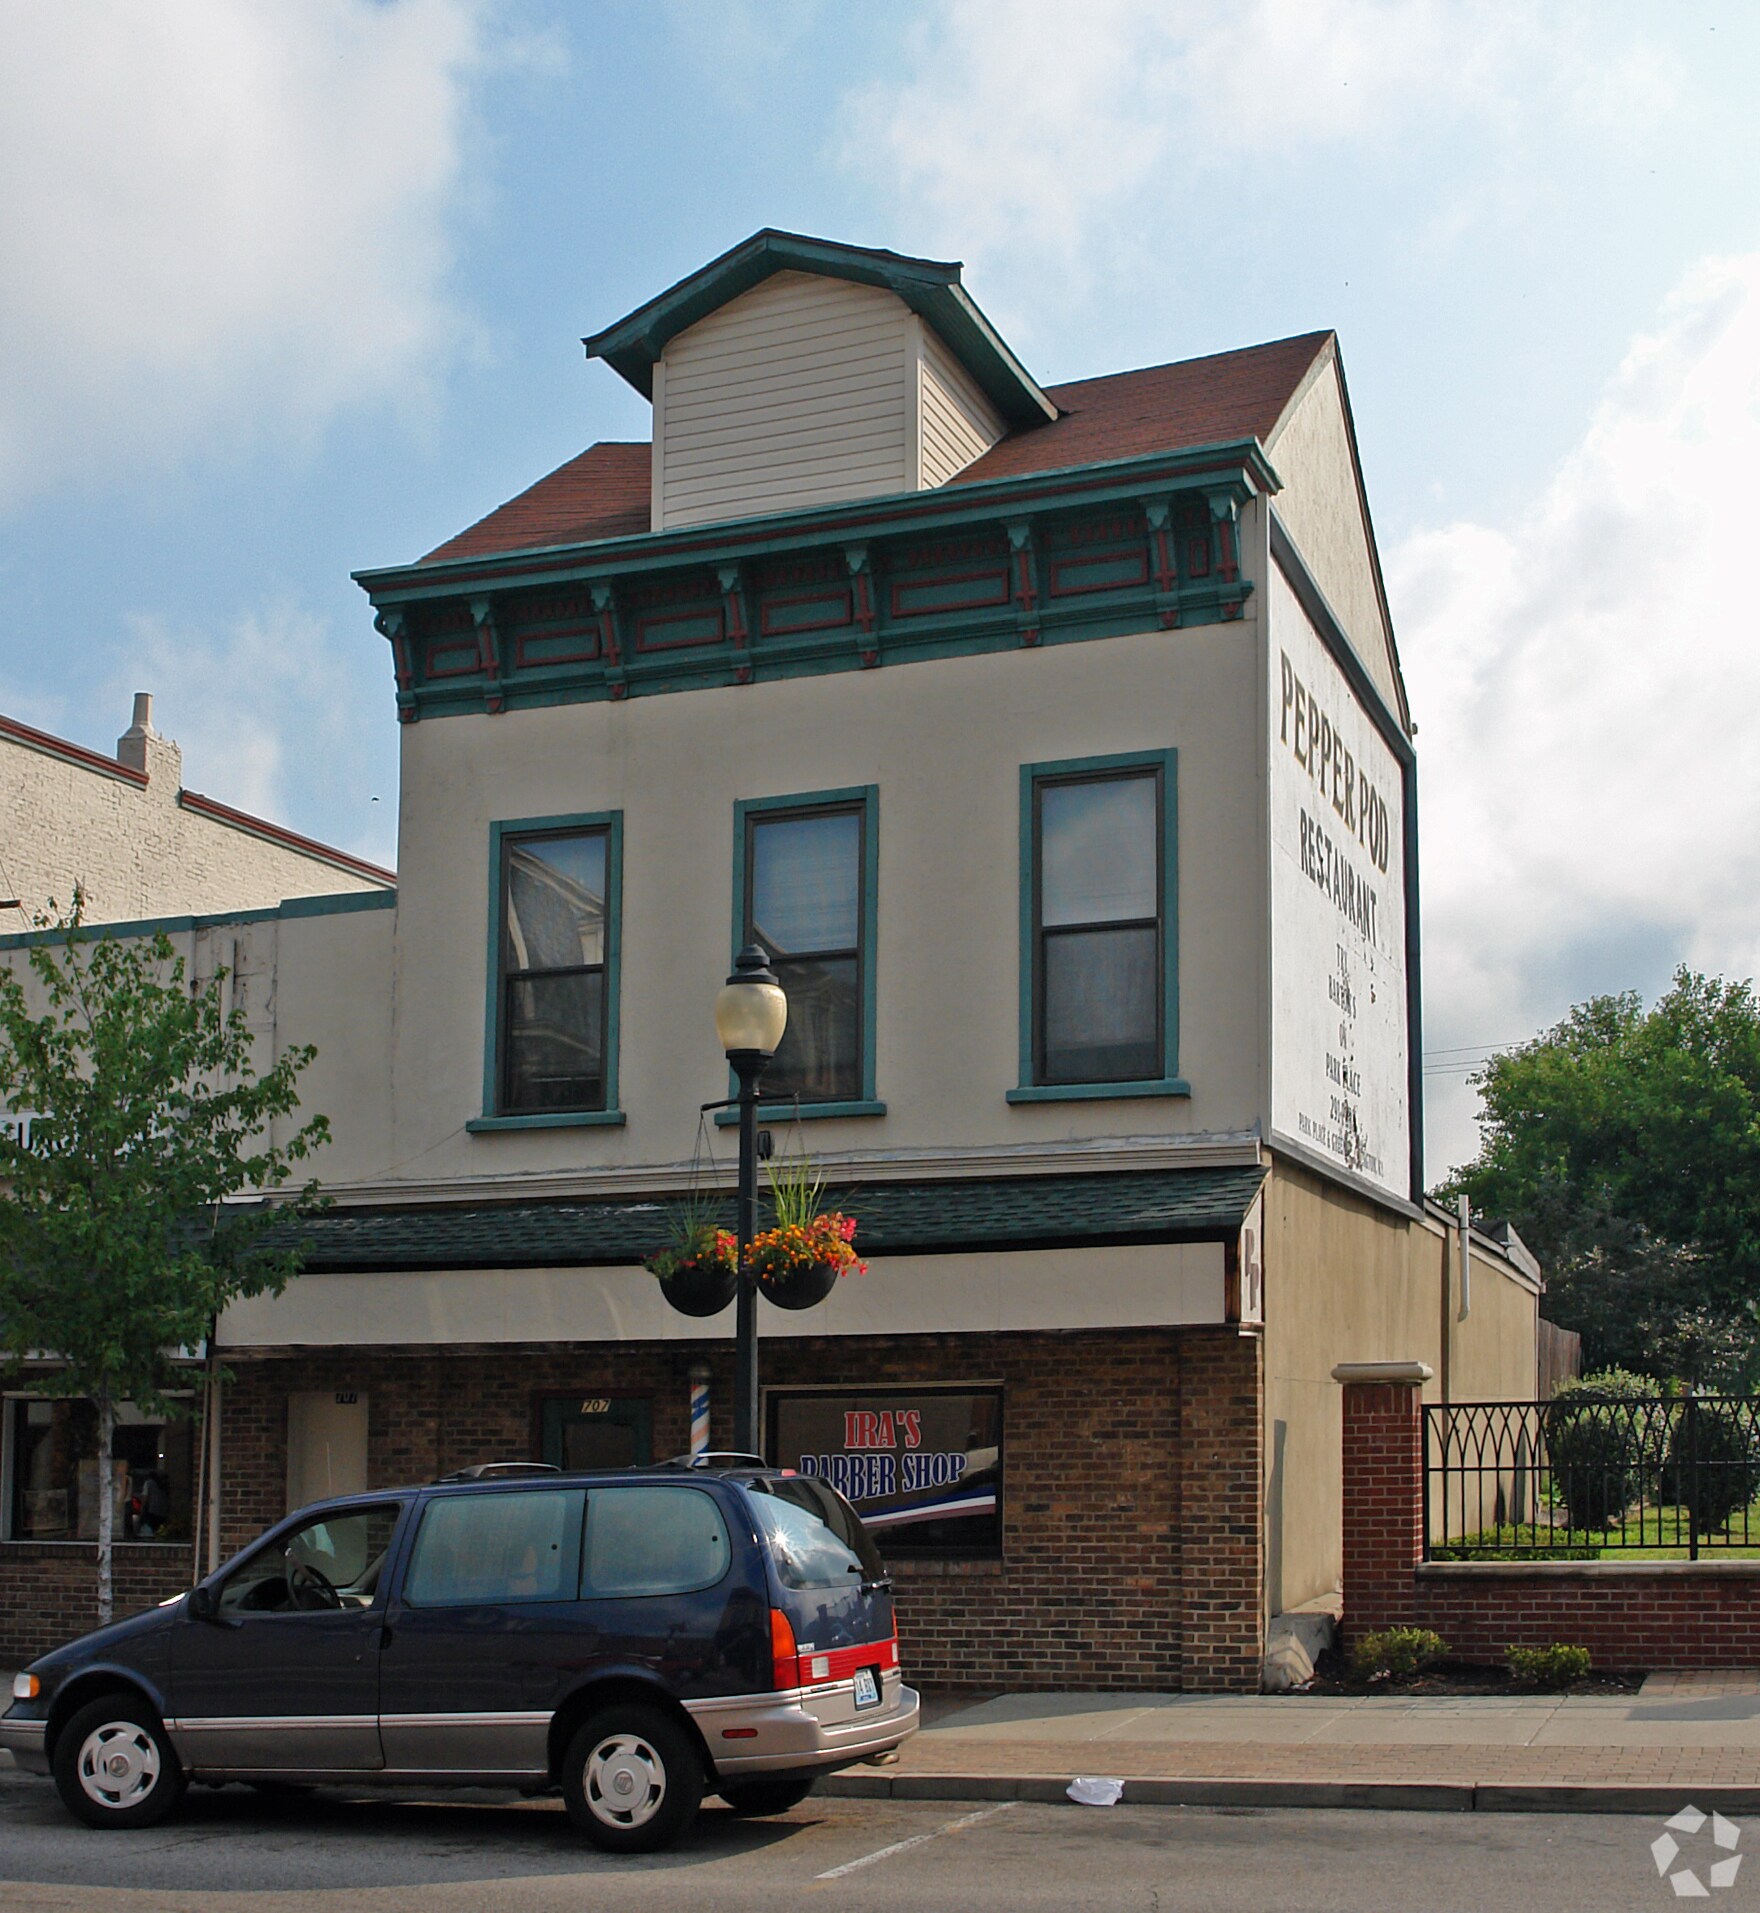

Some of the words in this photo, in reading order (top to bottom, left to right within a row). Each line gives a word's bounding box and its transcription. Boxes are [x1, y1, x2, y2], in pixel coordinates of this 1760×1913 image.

[1280, 646, 1356, 835] PEPPER
[1359, 767, 1389, 875] POD
[1300, 806, 1376, 948] RESTAURANT
[1326, 1052, 1341, 1086] PARK
[1298, 1111, 1311, 1136] PARK
[582, 1399, 610, 1412] 707
[844, 1409, 921, 1449] IRA'S
[902, 1453, 967, 1493] SHOP
